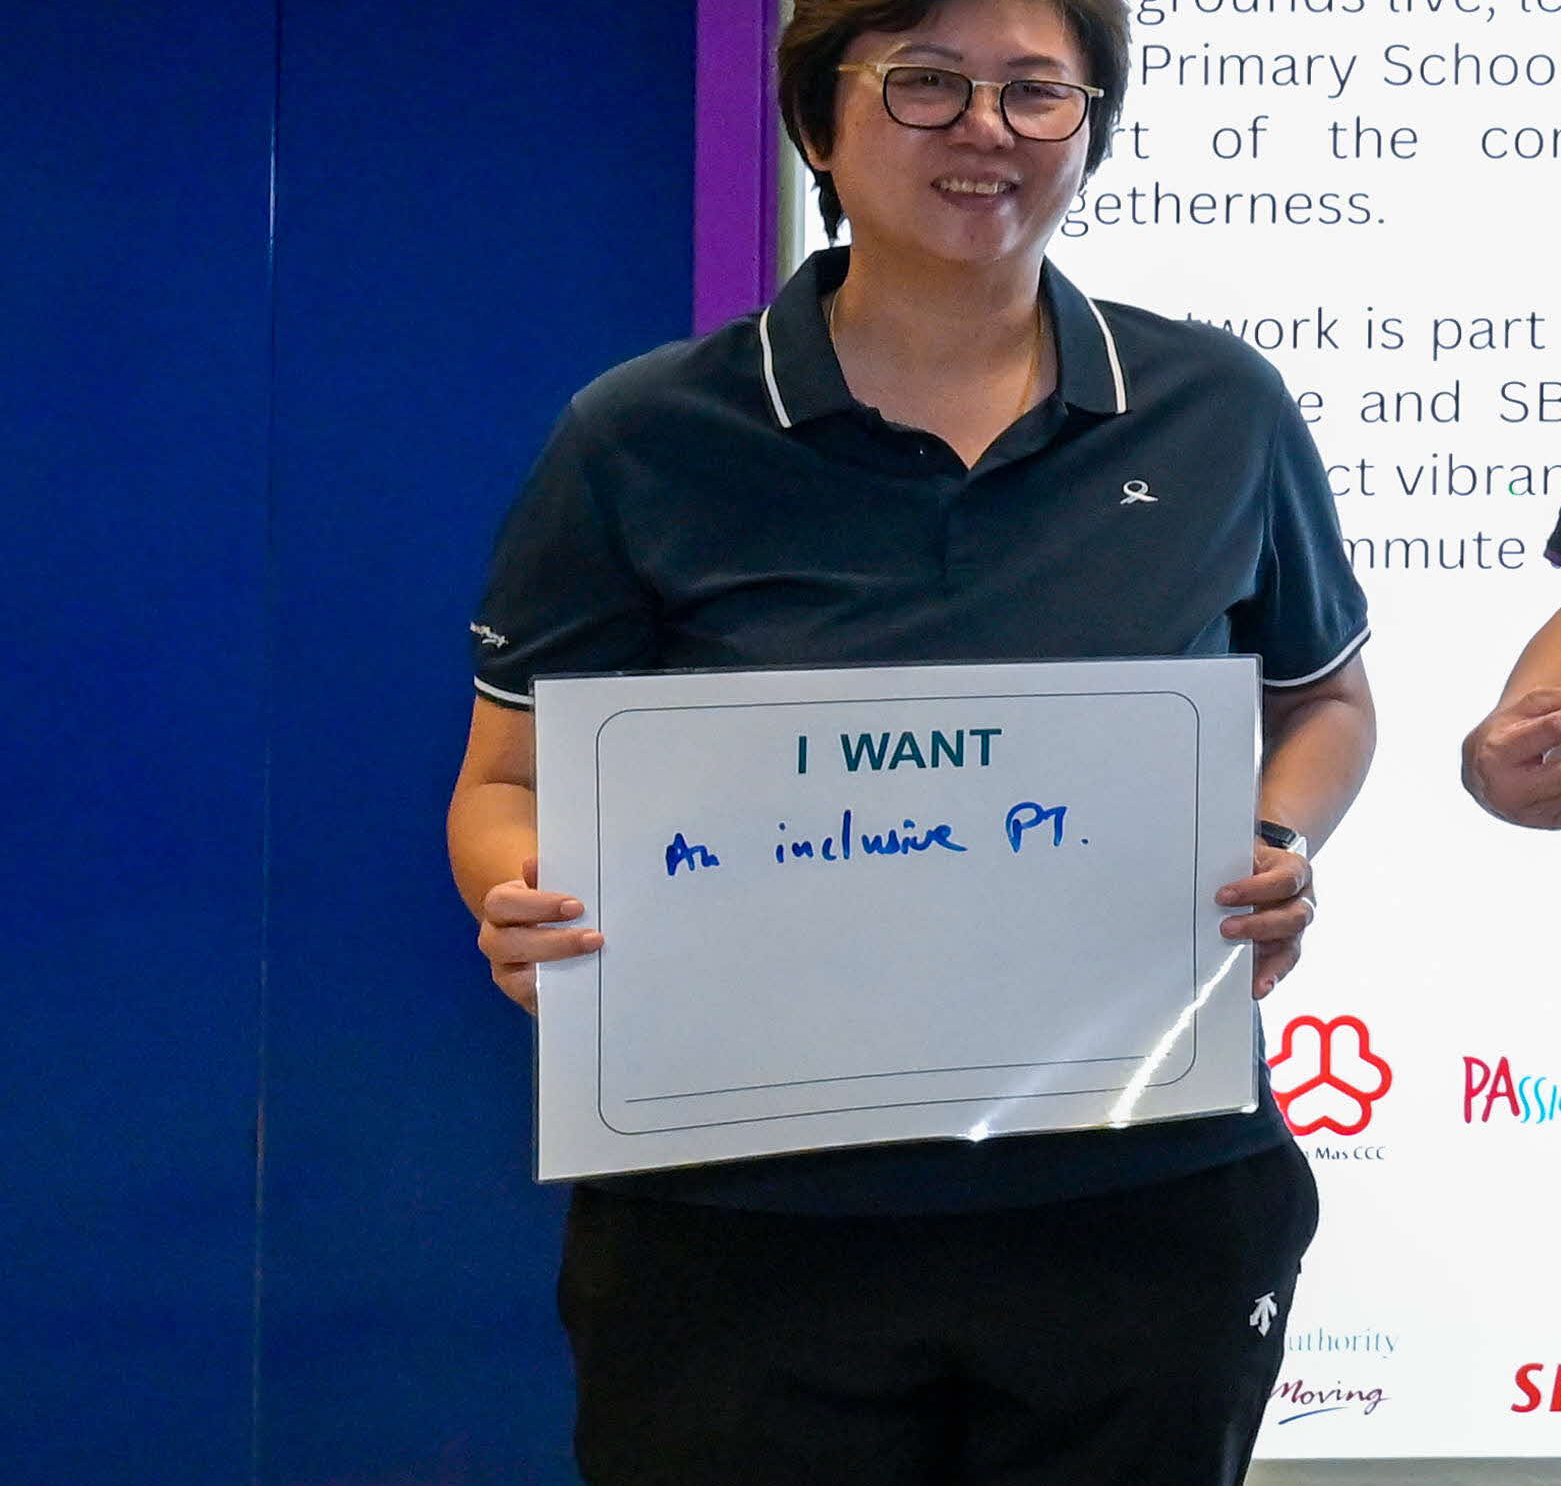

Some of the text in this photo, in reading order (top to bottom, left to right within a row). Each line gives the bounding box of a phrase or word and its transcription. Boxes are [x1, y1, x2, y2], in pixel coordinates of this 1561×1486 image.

[1141, 42, 1358, 100] Primary
[1211, 114, 1270, 160] of
[1327, 114, 1419, 160] the
[1366, 306, 1405, 351] is
[1432, 311, 1546, 362] part
[1359, 379, 1461, 424] and
[797, 728, 1003, 775] I WANT
[665, 832, 720, 876] An
[775, 808, 968, 864] inclusive
[1315, 1147, 1349, 1160] Mas
[1353, 1146, 1386, 1161] CCC
[1288, 1327, 1400, 1359] uthority
